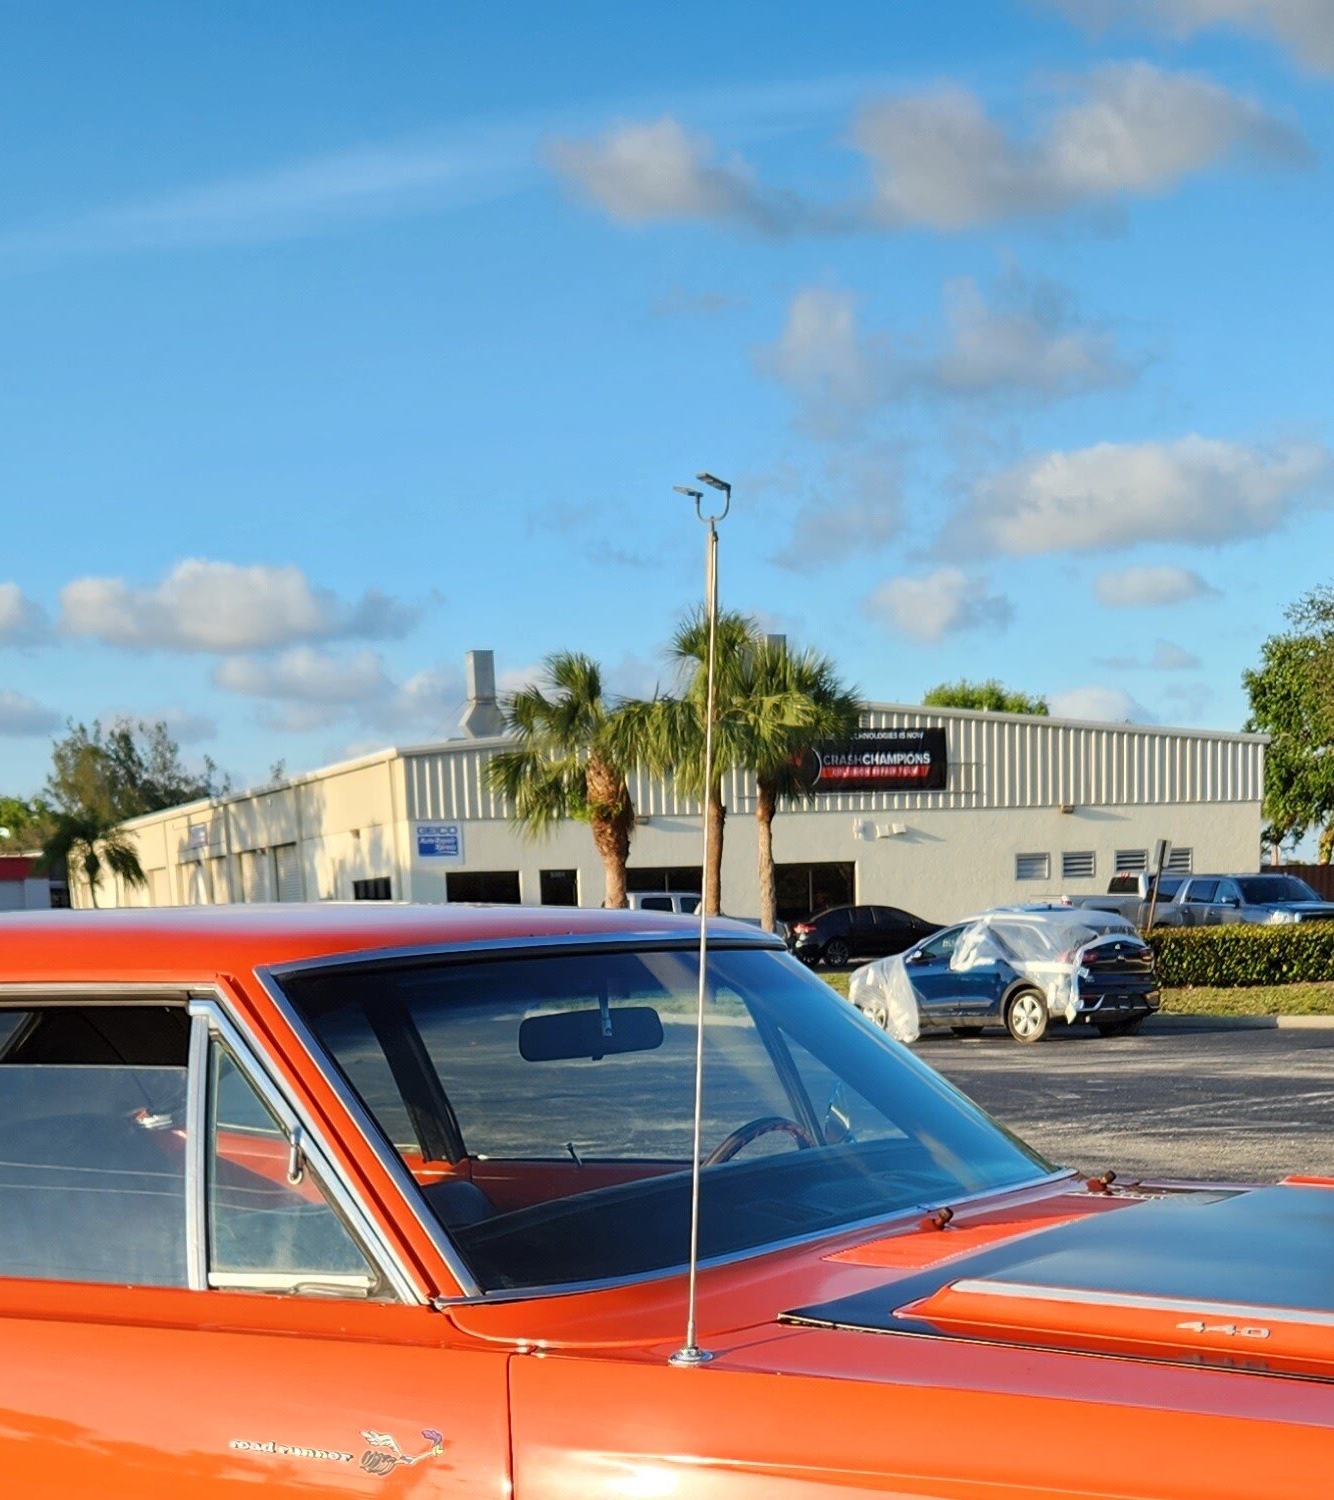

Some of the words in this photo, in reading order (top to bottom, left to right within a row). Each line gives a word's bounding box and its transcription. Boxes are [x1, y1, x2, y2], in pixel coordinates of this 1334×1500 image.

[417, 826, 458, 835] GEICO
[1175, 1321, 1271, 1339] 440
[229, 1440, 277, 1454] road
[278, 1444, 354, 1462] runner
